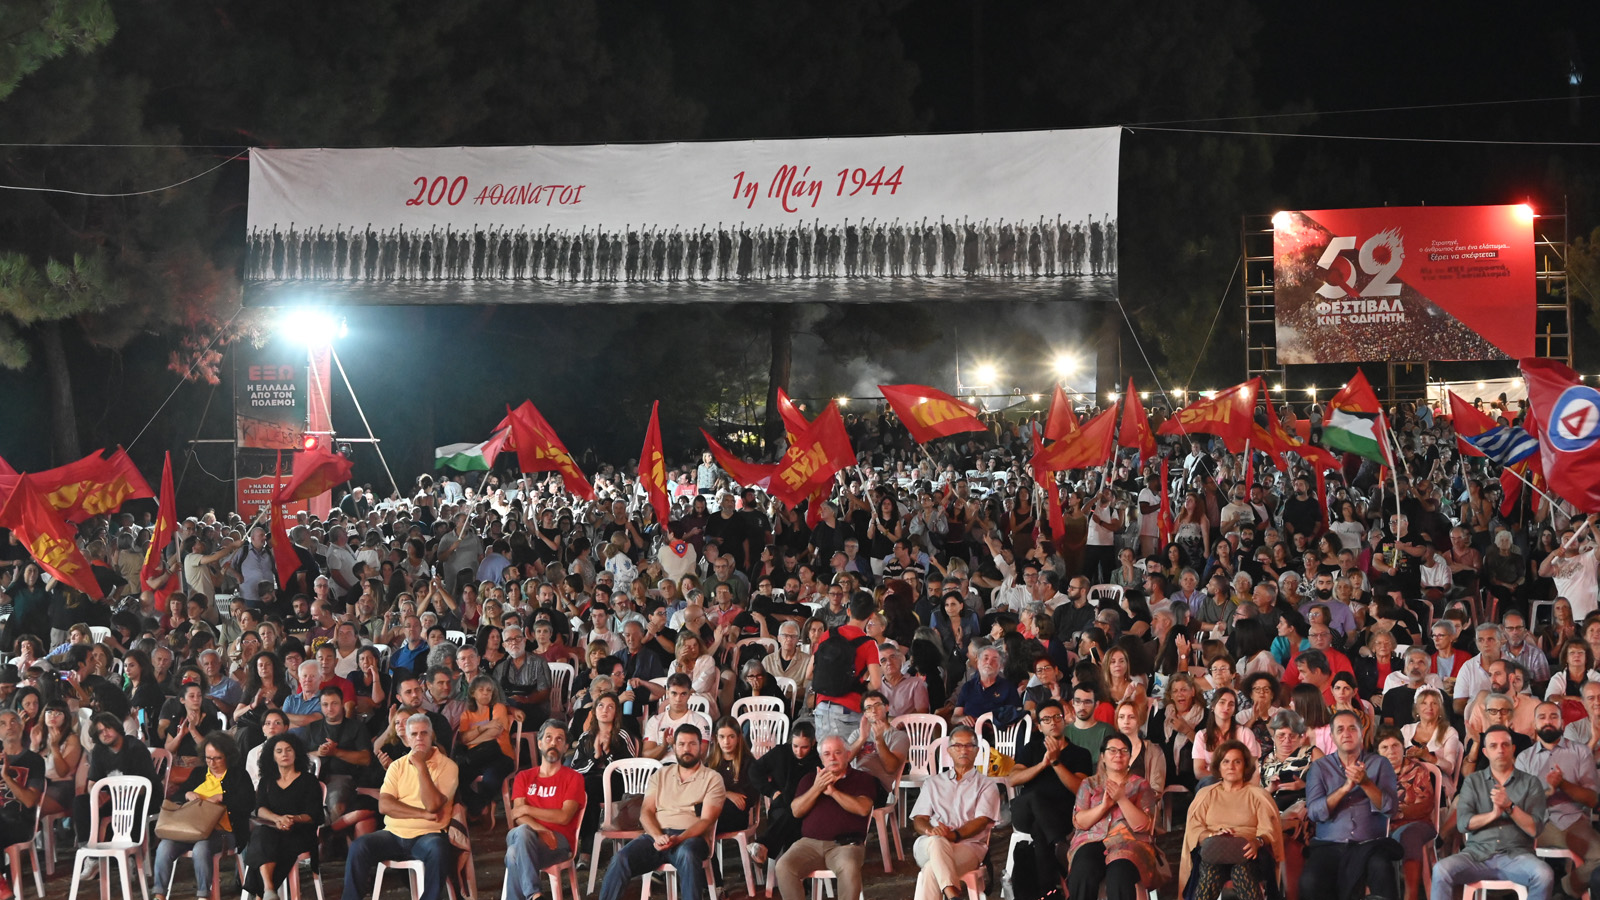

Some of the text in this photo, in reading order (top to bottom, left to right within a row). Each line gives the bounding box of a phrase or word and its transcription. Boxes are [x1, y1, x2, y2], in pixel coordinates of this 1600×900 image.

[406, 175, 468, 206] 200
[732, 164, 905, 213] 1η Μάη 1944
[1316, 299, 1404, 315] ΦΕΣΤΙΒΑΛ
[1317, 312, 1405, 325] ΚΝΕ ΟΔΗΓΗΤΗ
[249, 365, 294, 380] ΕΞΩ
[256, 383, 296, 391] ΕΛΛΑΔΑ
[537, 786, 557, 797] ALU
